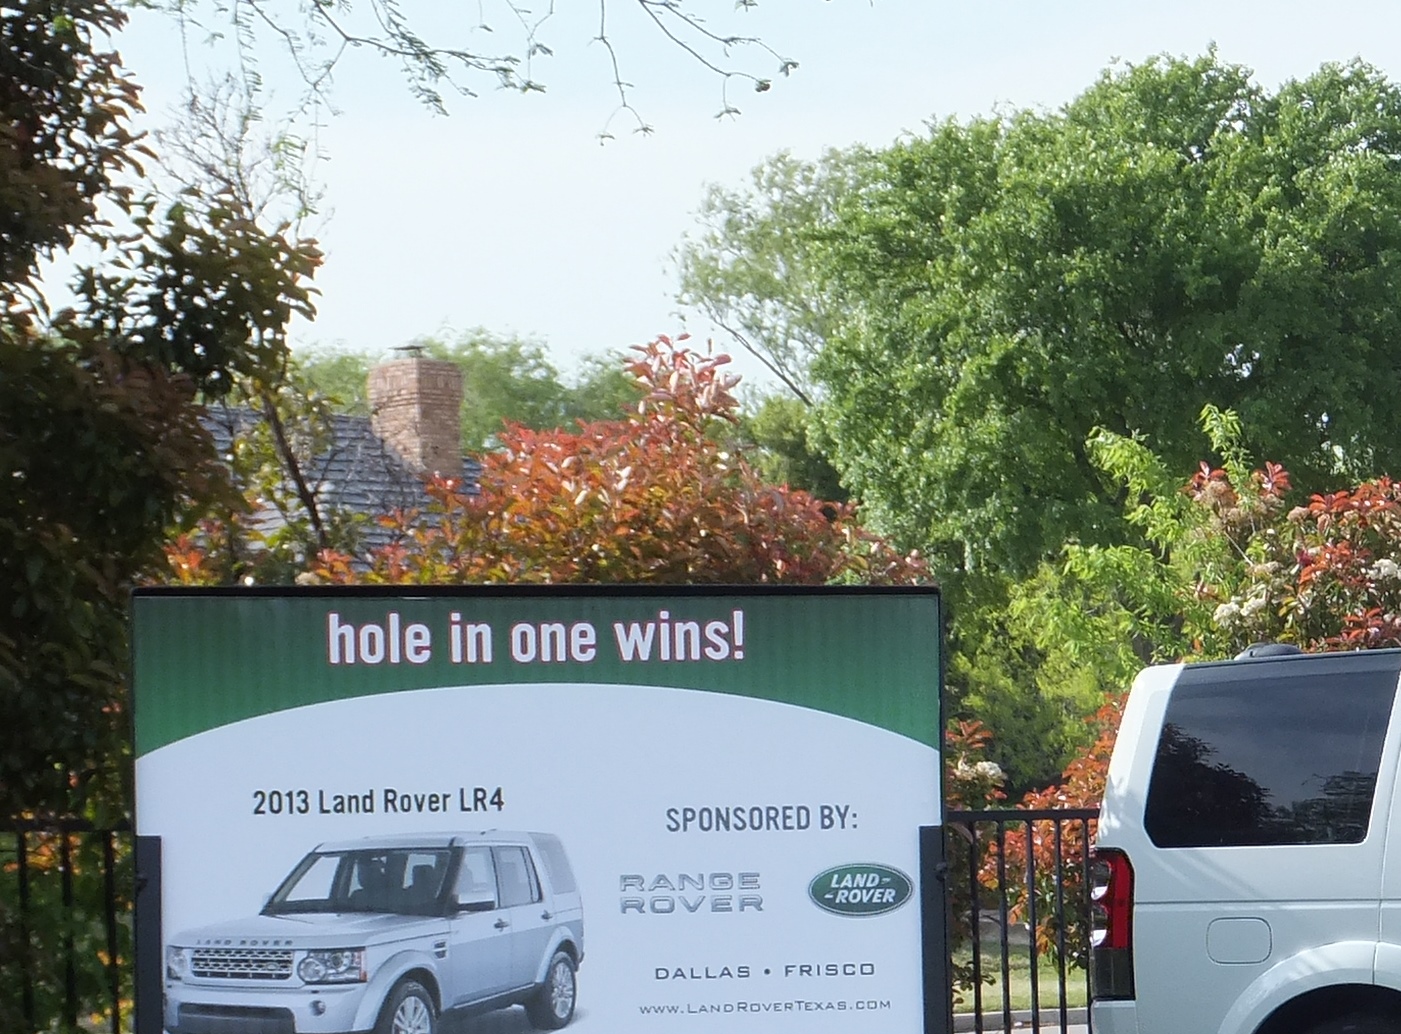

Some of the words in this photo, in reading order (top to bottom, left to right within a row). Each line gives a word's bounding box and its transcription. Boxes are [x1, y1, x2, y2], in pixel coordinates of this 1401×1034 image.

[328, 612, 431, 664] hole
[449, 612, 493, 664] in
[511, 621, 597, 663] one
[613, 610, 744, 661] wins!
[253, 790, 309, 815] 2013
[318, 789, 374, 814] Land
[384, 788, 450, 813] Rover
[459, 786, 504, 812] LR4
[666, 805, 810, 832] SPONSORED
[820, 804, 858, 830] BY:
[619, 872, 761, 892] RANGE
[619, 894, 764, 914] ROVER
[655, 965, 751, 980] DALLAS
[784, 963, 876, 978] FRISCO
